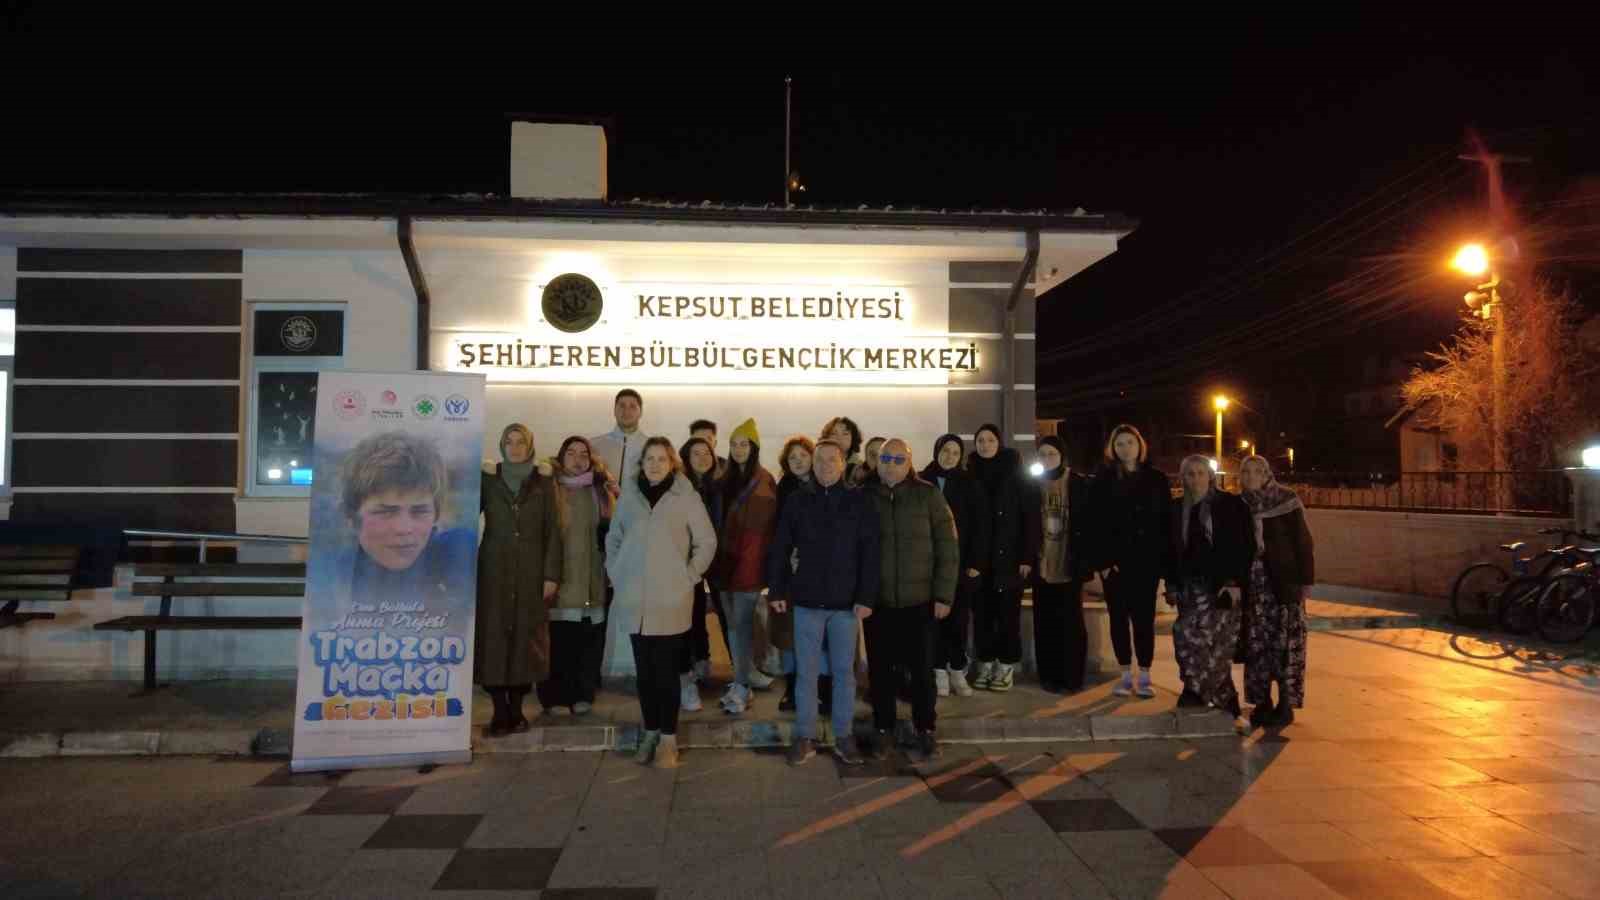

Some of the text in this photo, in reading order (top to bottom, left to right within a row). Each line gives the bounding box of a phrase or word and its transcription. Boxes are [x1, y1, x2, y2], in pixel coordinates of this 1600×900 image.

[638, 291, 902, 319] KEPSUT BELEDİYESİ
[460, 338, 976, 370] ŞEHİT EREN BÜLBÜL GENÇLİK MERKEZİ
[313, 630, 466, 664] Trabzon
[325, 661, 449, 698] Maçka
